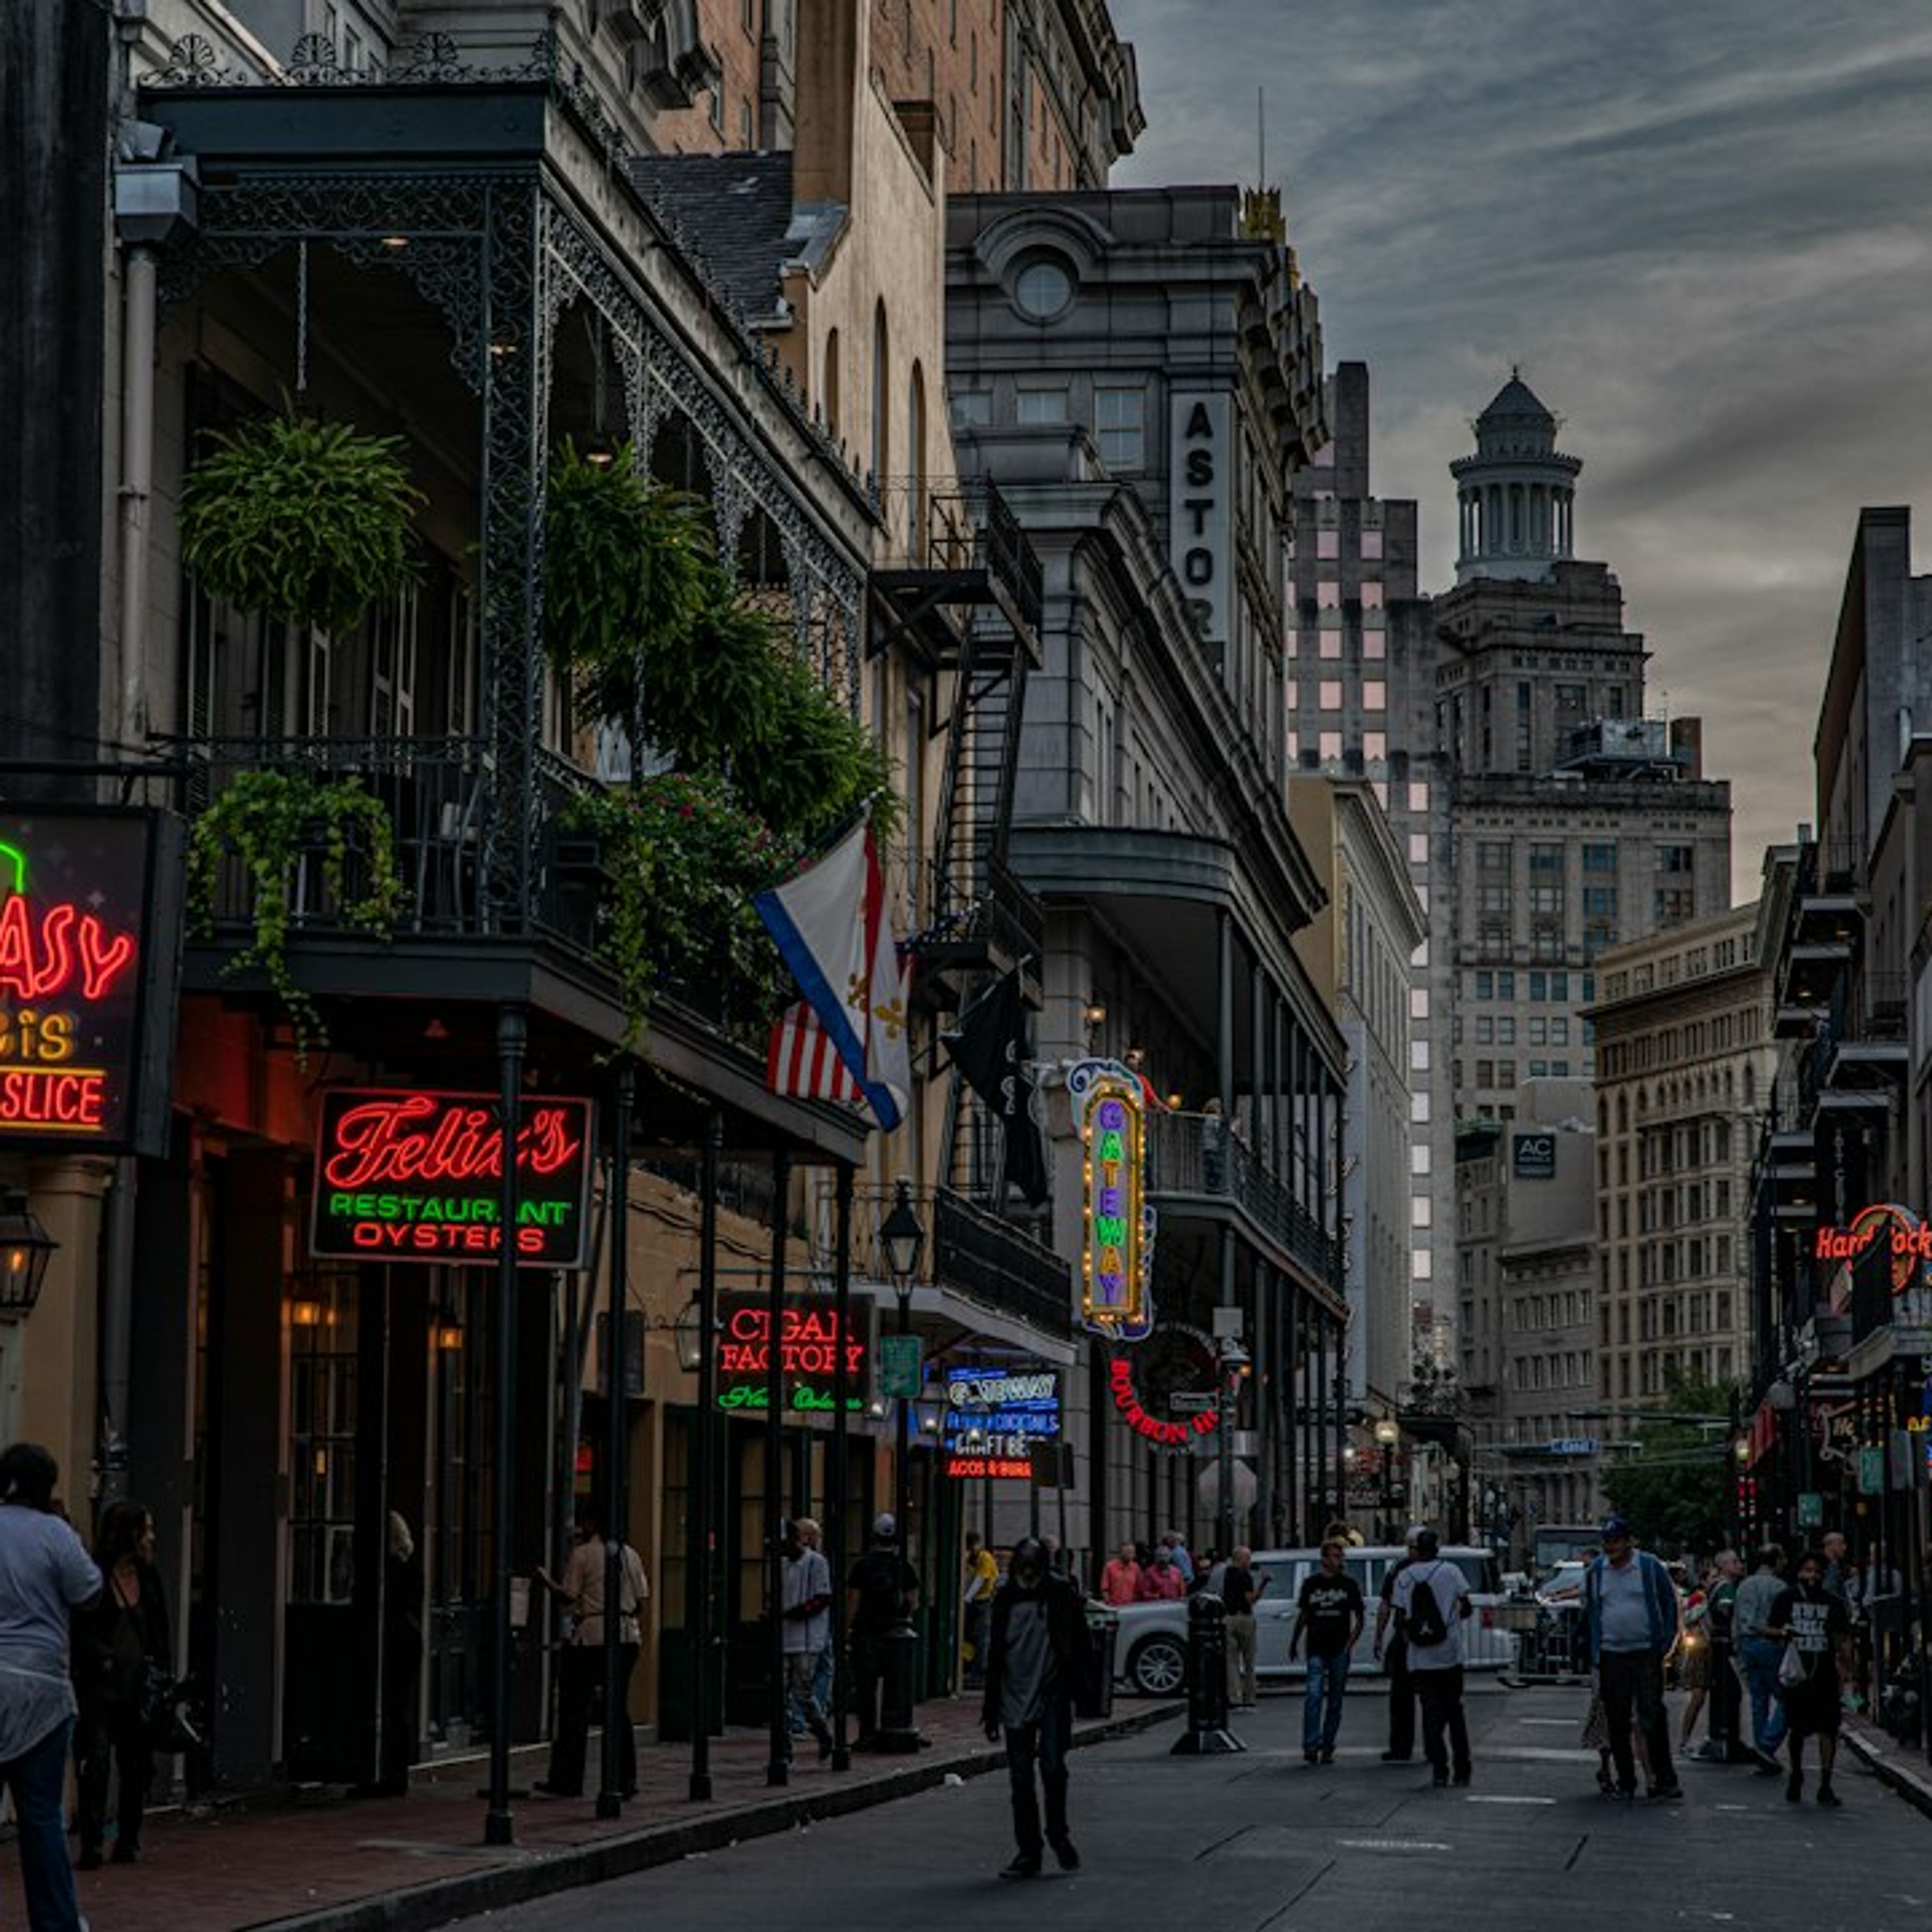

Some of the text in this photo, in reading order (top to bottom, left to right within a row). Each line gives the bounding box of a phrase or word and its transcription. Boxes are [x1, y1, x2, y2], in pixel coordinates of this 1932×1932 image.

[1184, 401, 1214, 635] ASTOR
[2, 1073, 103, 1123] SLICE
[1519, 1138, 1552, 1156] AC
[329, 1192, 572, 1225] RESTAURNT
[1095, 1100, 1127, 1303] GATEWAY
[1890, 1220, 1932, 1258] ock
